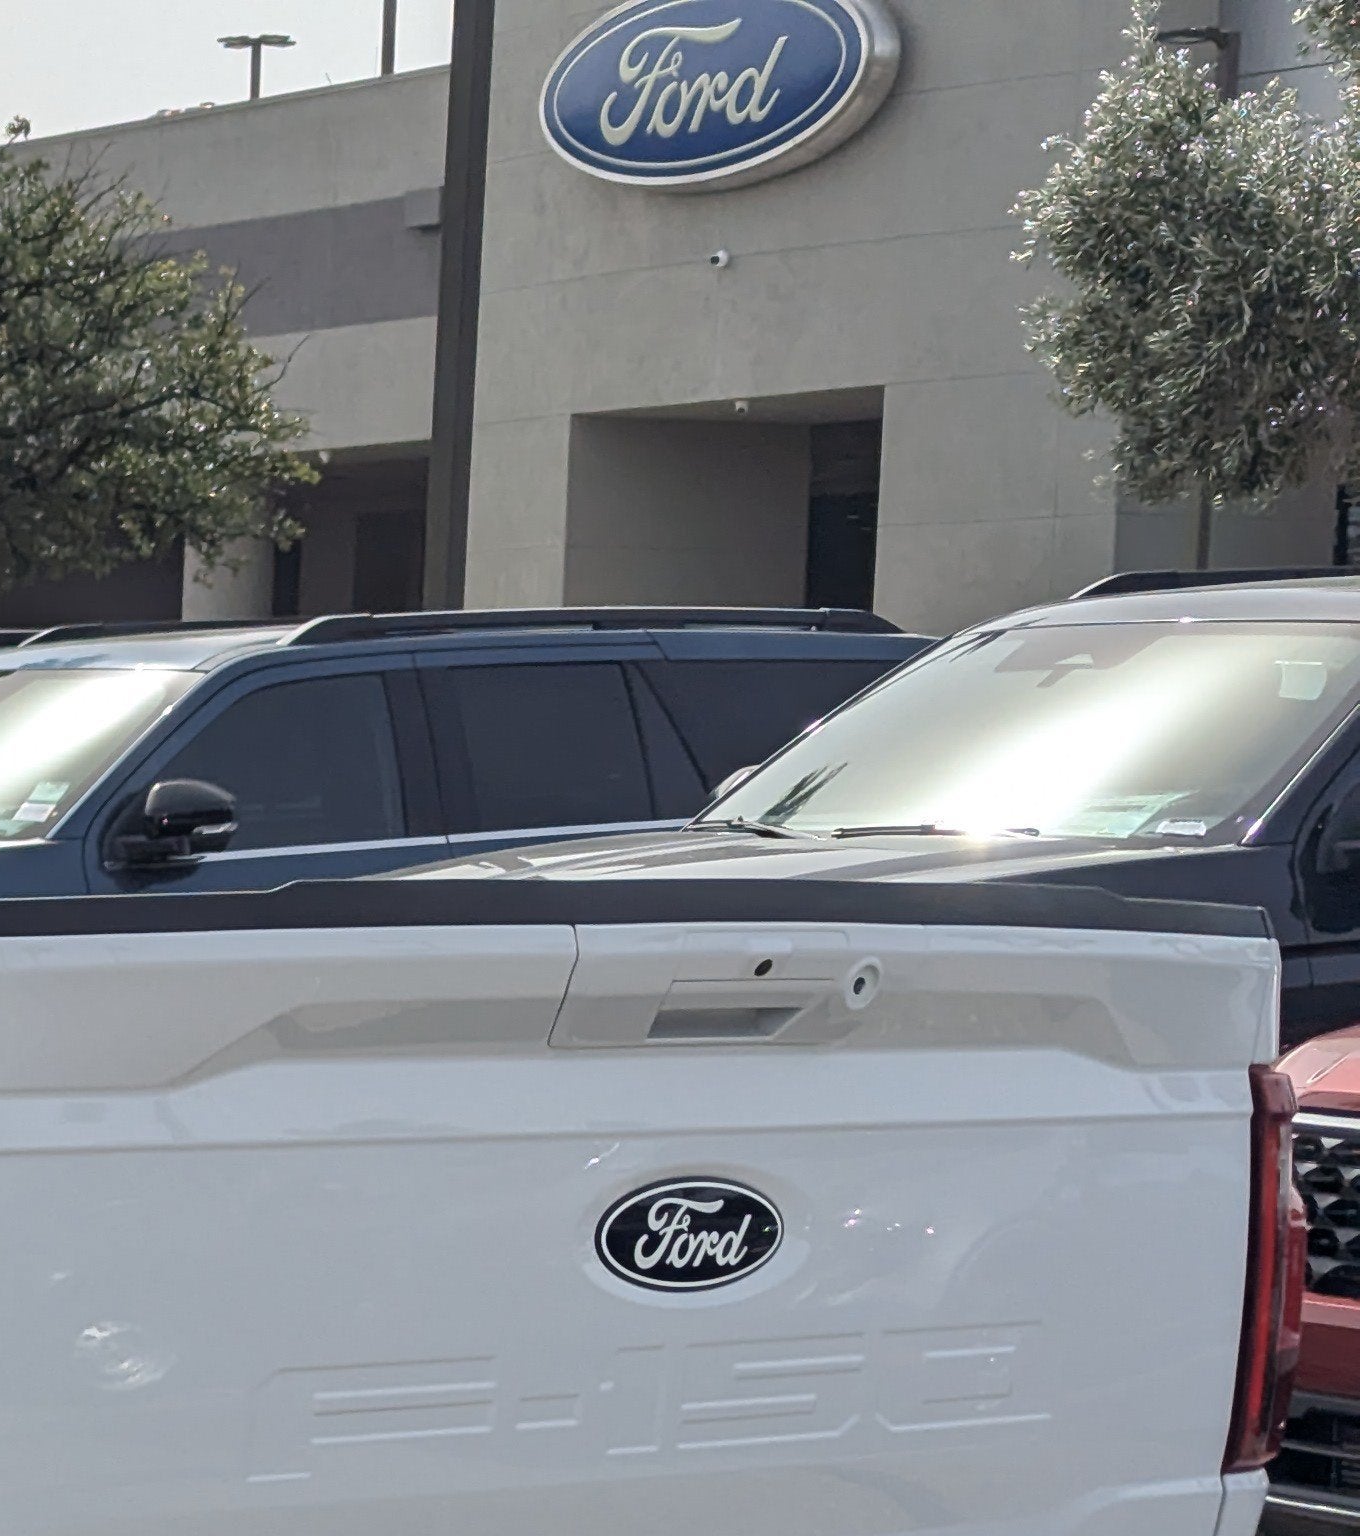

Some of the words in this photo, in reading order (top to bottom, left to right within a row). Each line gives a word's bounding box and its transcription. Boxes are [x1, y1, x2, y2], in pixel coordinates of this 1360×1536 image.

[600, 17, 789, 146] Ford
[633, 1197, 753, 1270] Ford
[245, 1319, 1053, 1484] F-150
